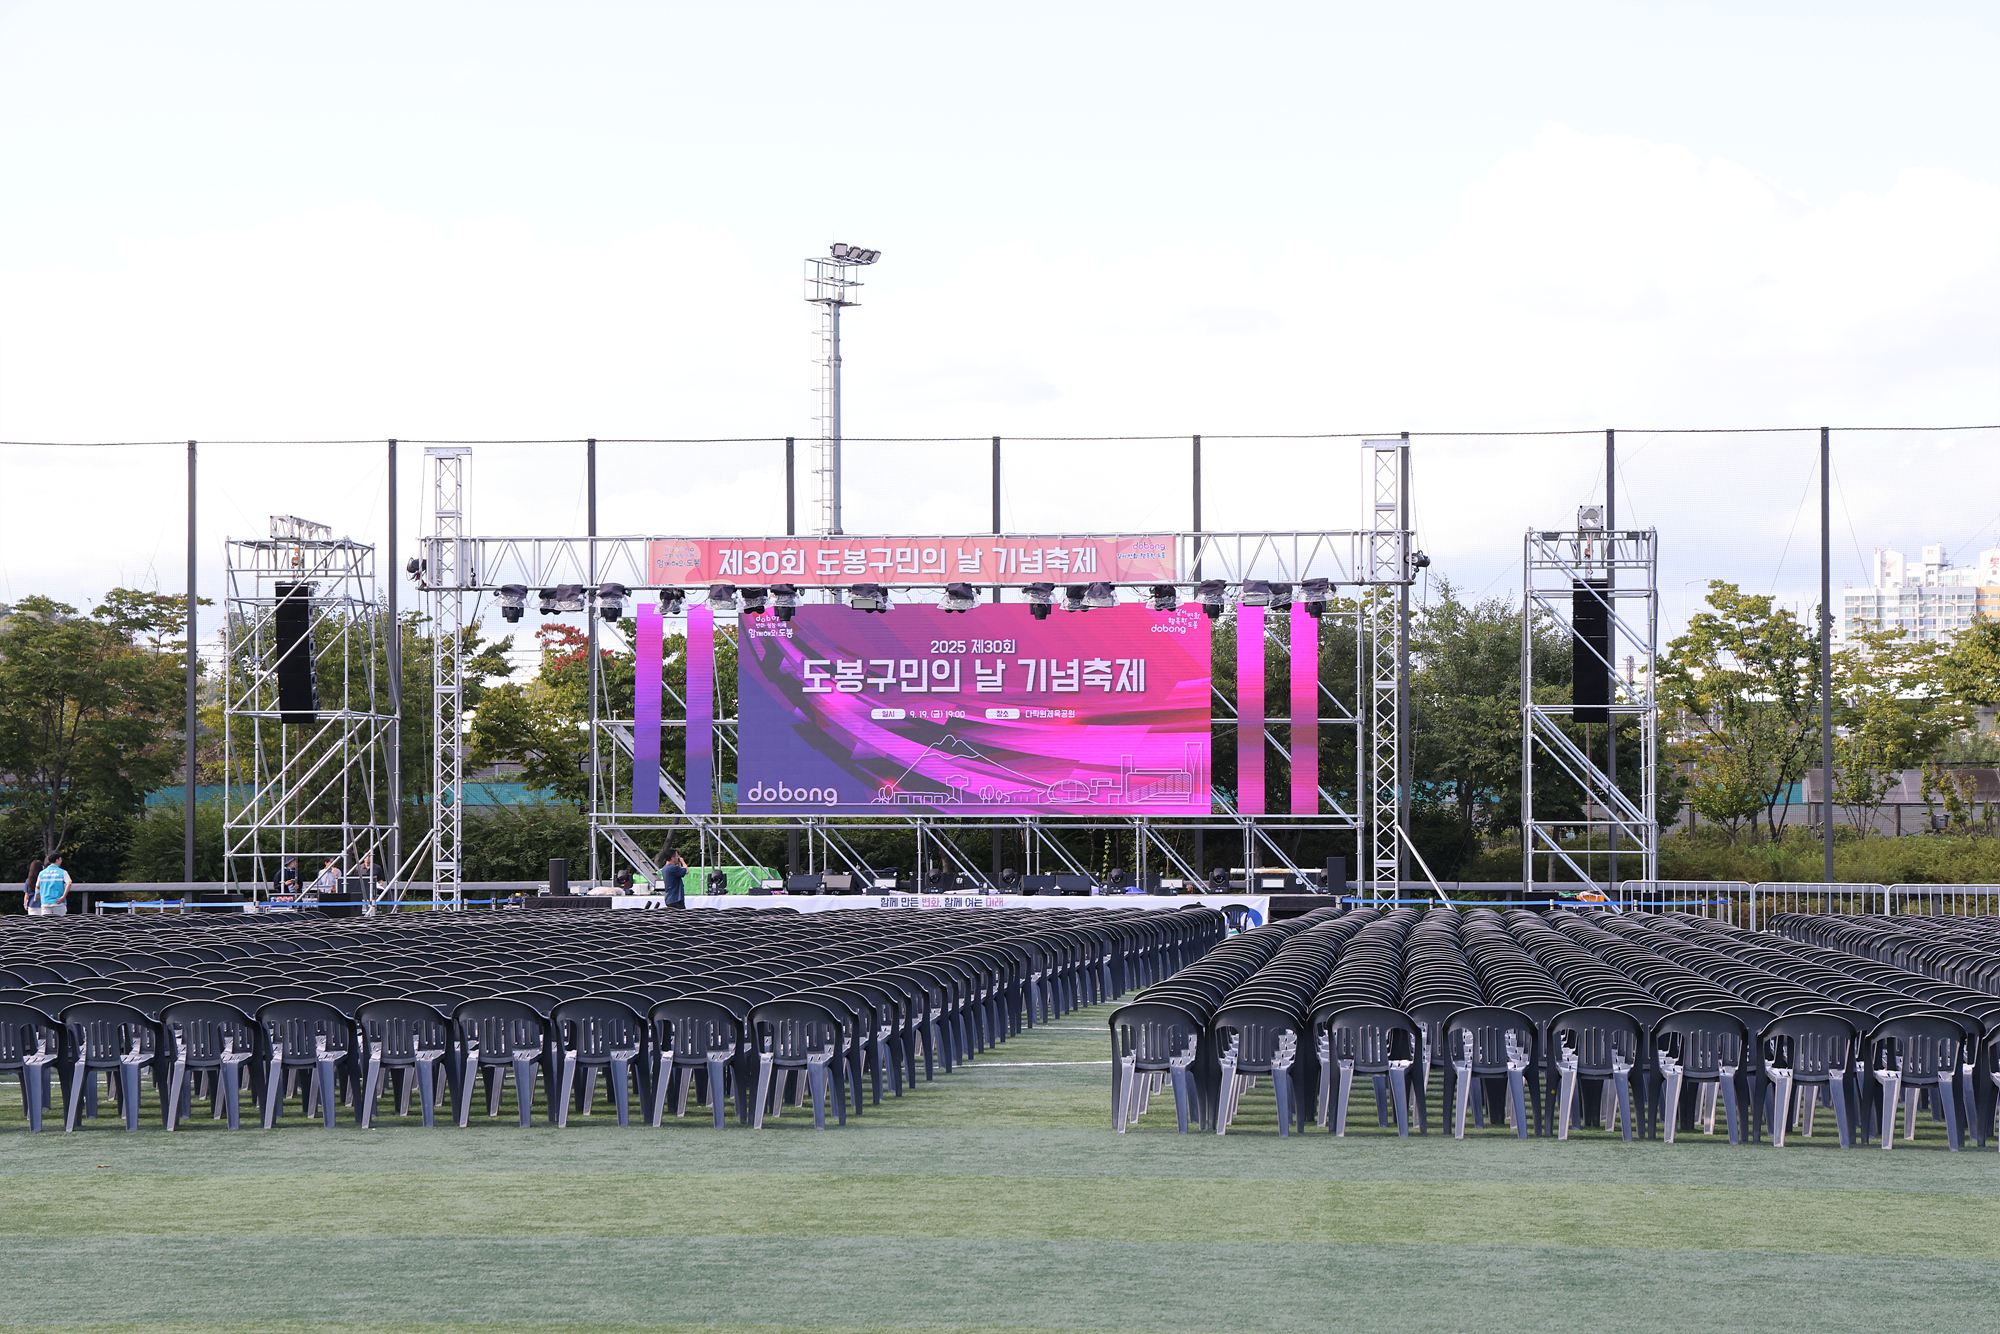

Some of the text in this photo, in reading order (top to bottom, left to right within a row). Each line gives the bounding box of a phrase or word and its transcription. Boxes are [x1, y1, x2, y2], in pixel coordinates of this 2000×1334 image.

[1132, 541, 1166, 551] dobong
[718, 546, 1097, 576] 제30회 도봉구민의 날 기념축제
[778, 628, 794, 639] 도봉
[1150, 623, 1187, 635] dobong
[930, 638, 1016, 654] 2025 제30회
[802, 657, 1146, 693] 도봉구민의 날 기념축제
[881, 710, 895, 718] 일시
[909, 710, 966, 719] 9. 19. (금) 19:00
[996, 710, 1009, 718] 장소
[1025, 710, 1076, 719] 다락원체육공원
[747, 780, 838, 807] dobong
[880, 896, 899, 908] 함께
[901, 896, 919, 908] 만든
[944, 896, 963, 908] 함께
[965, 896, 983, 908] 여는
[985, 896, 1004, 907] 미래
